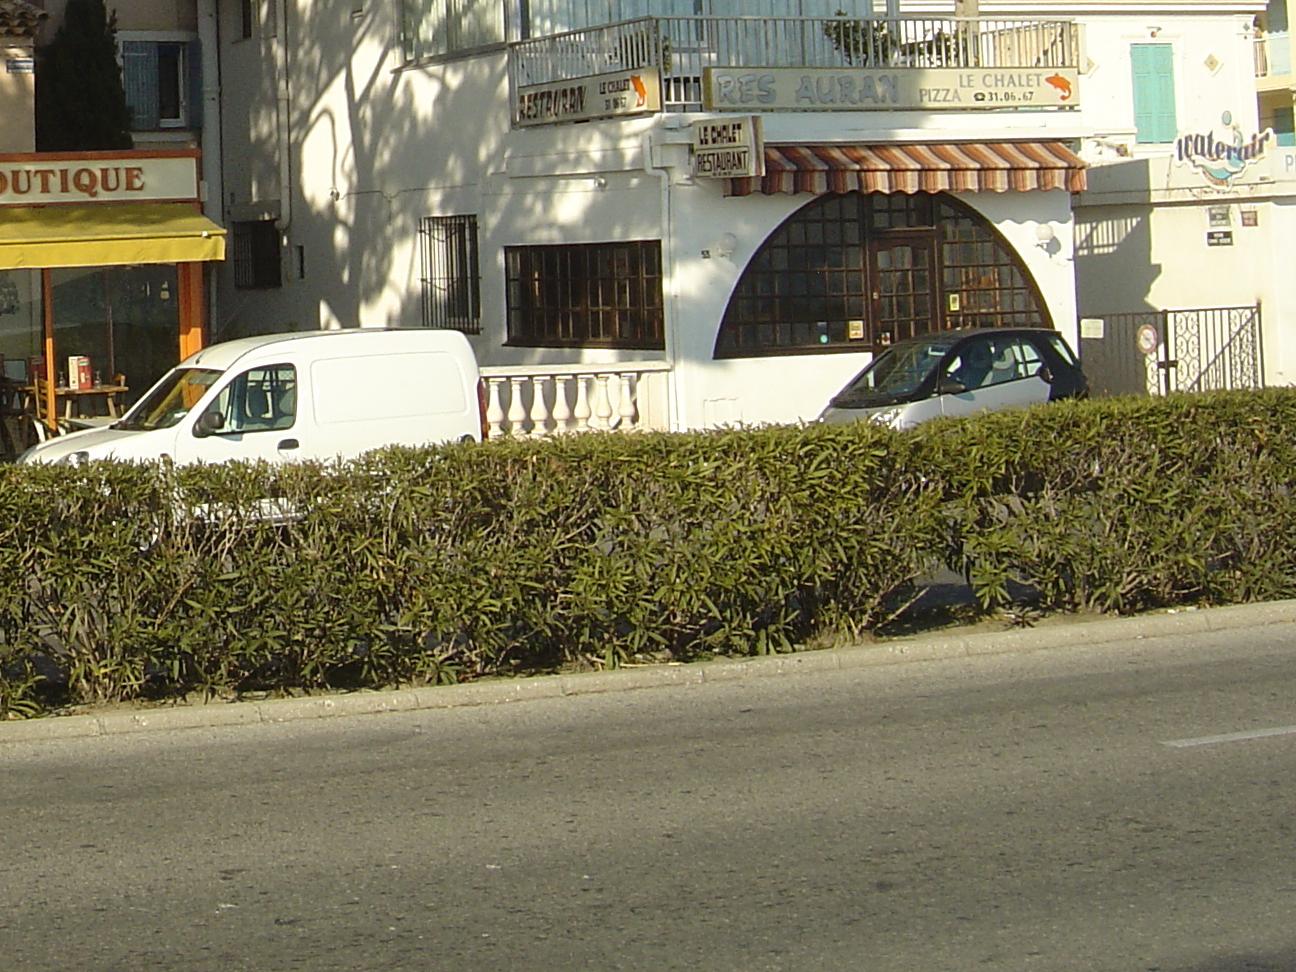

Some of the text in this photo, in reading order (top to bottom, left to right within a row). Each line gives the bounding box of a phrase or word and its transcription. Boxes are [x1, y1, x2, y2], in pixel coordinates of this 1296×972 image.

[599, 78, 630, 95] LE CHALET
[959, 73, 1043, 88] LE CHALET
[919, 88, 962, 103] PIZZA
[988, 91, 1034, 102] 31.06.67
[698, 123, 742, 145] LE CHALET
[697, 150, 748, 173] RESTAURANT
